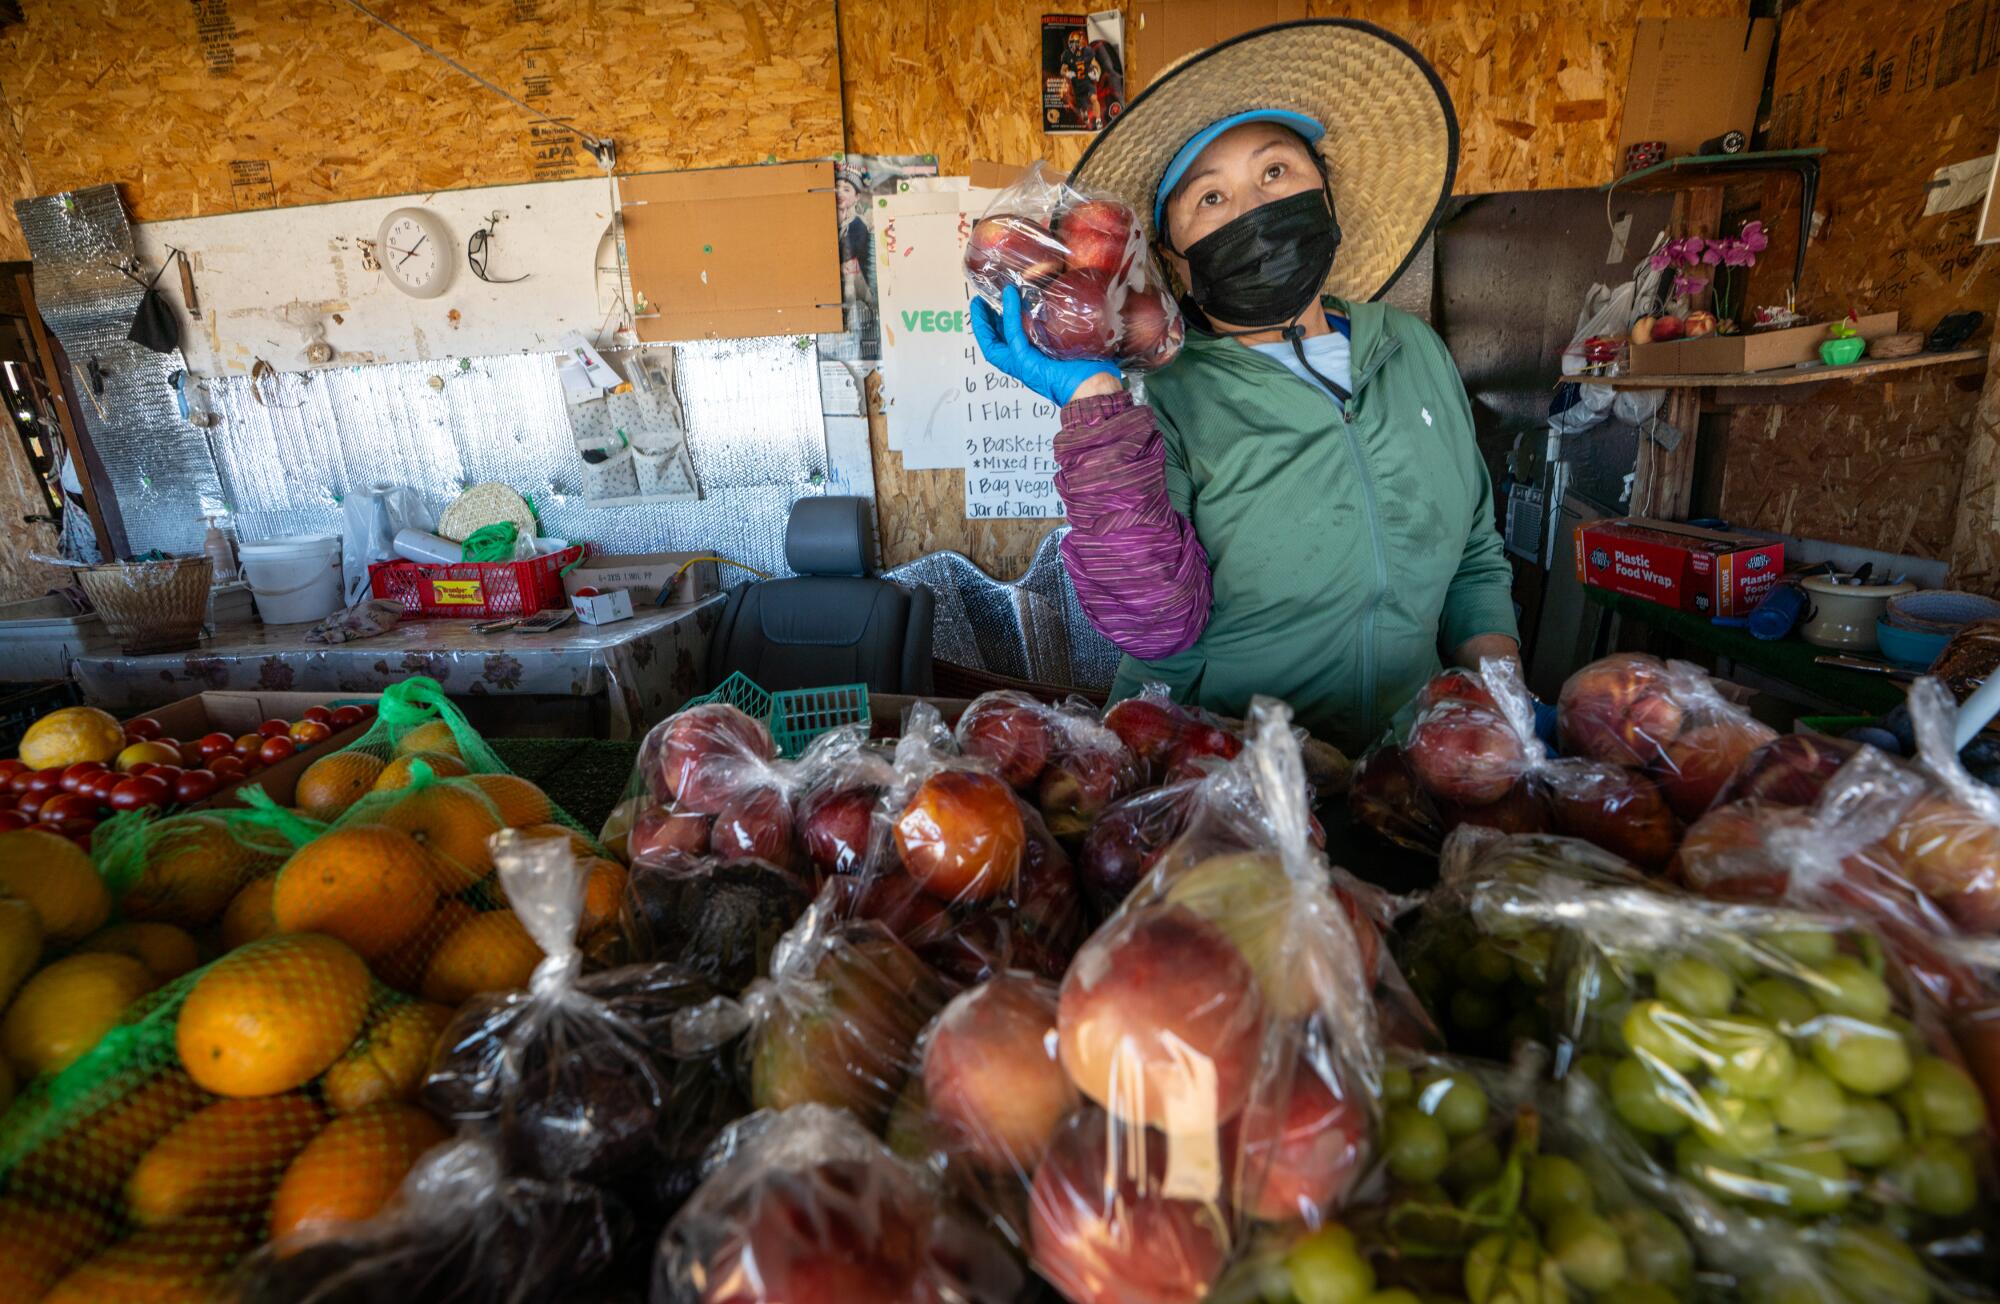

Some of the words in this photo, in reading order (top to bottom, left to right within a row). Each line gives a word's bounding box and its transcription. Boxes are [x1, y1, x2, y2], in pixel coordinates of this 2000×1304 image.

[901, 310, 963, 333] VEGE
[964, 346, 976, 365] 4
[965, 377, 977, 393] 6
[984, 372, 1024, 391] Bas
[982, 400, 1022, 421] Flat
[1032, 402, 1057, 419] (12)
[966, 439, 977, 455] 3
[983, 434, 1055, 454] Baskets
[979, 478, 1010, 497] Bag
[969, 502, 993, 518] Jar
[996, 500, 1011, 516] of
[1012, 501, 1047, 517] Jam
[1615, 550, 1650, 568] Plastic
[1616, 563, 1641, 580] Food
[1641, 569, 1673, 589] Wrap
[1740, 571, 1776, 586] Plastic
[1745, 583, 1770, 596] Food
